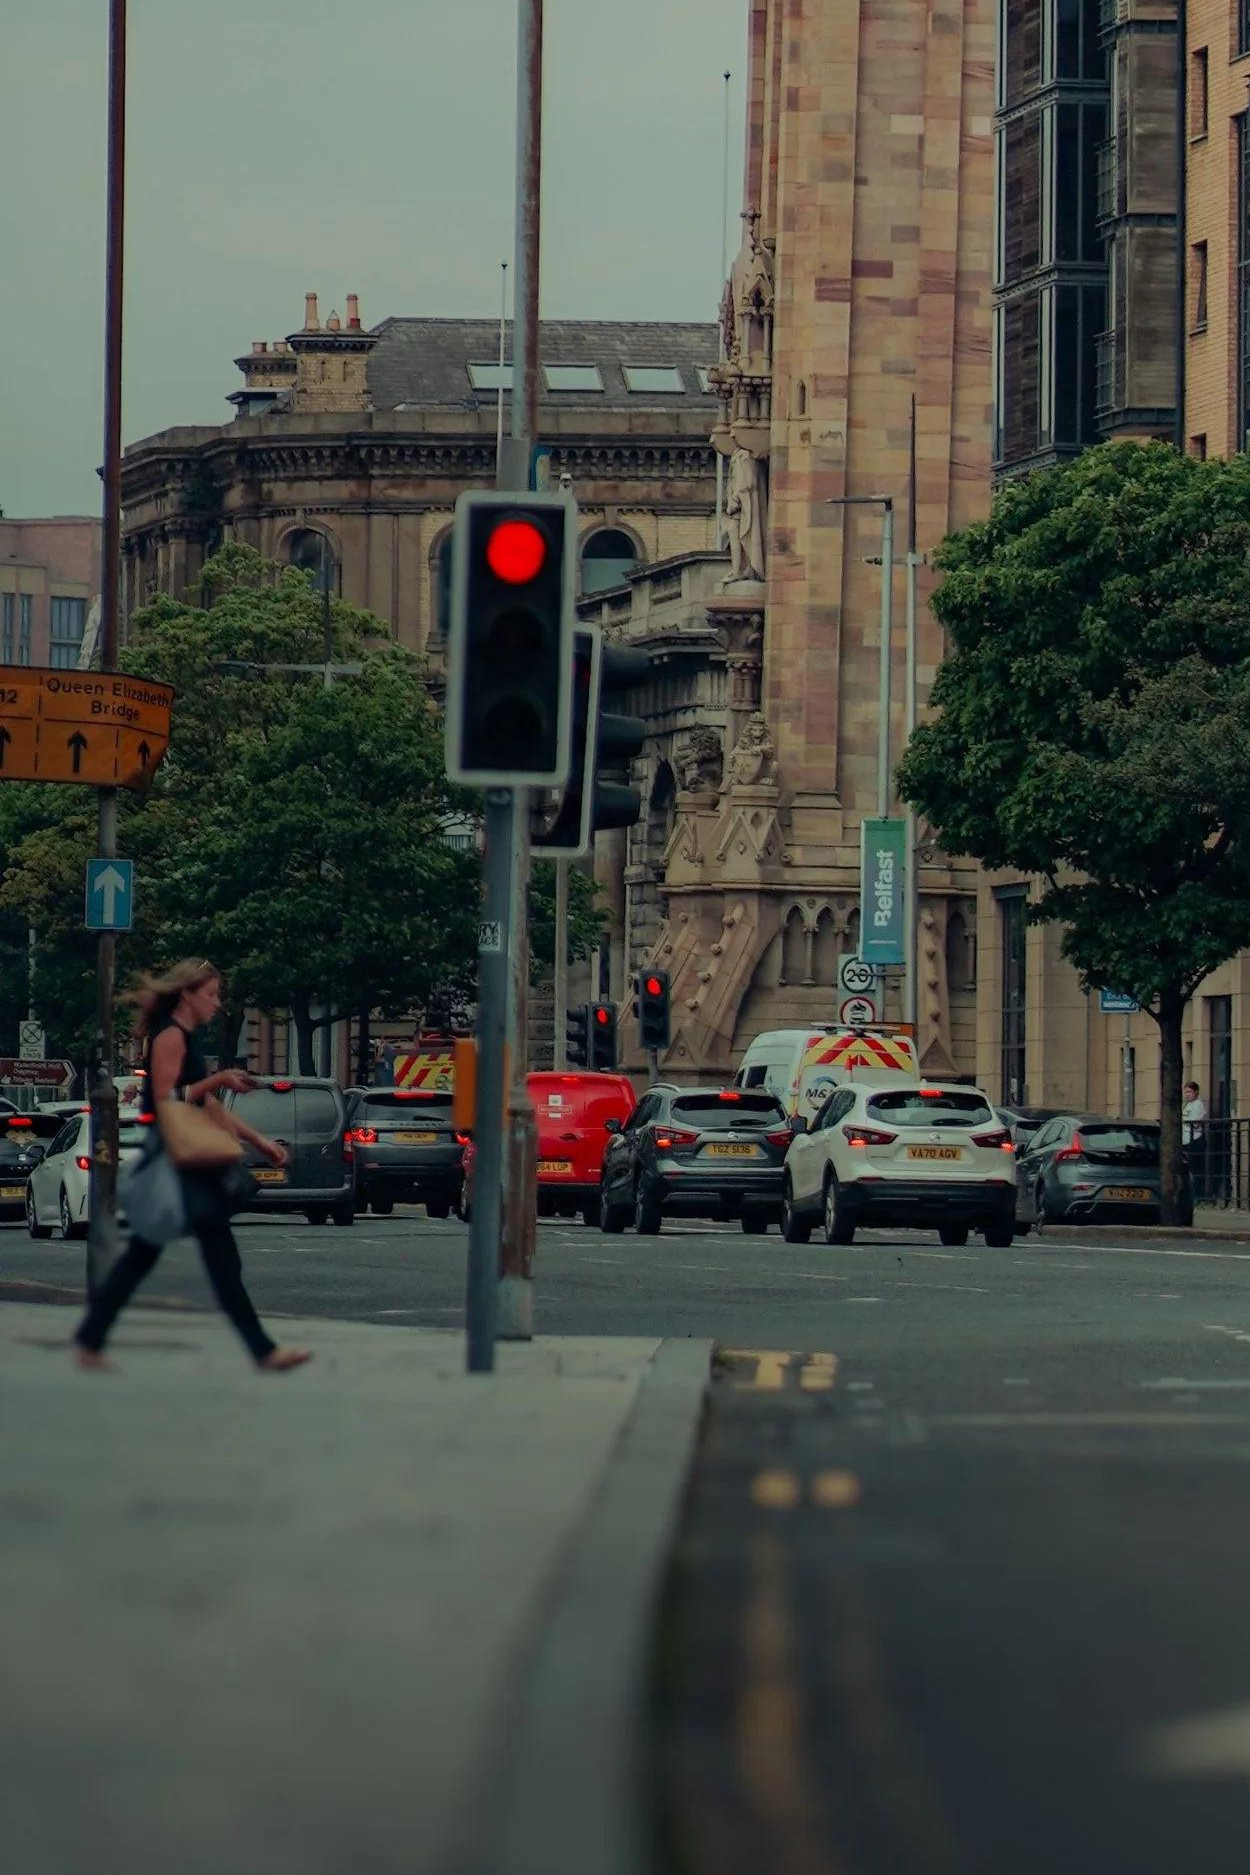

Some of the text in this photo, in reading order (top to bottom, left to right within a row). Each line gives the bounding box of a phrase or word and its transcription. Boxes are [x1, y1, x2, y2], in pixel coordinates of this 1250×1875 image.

[47, 677, 169, 709] Queen Elizabeth
[91, 699, 140, 721] Bridge
[874, 849, 894, 927] Belfast
[847, 969, 868, 982] 20
[911, 1148, 957, 1159] VA70 AGV
